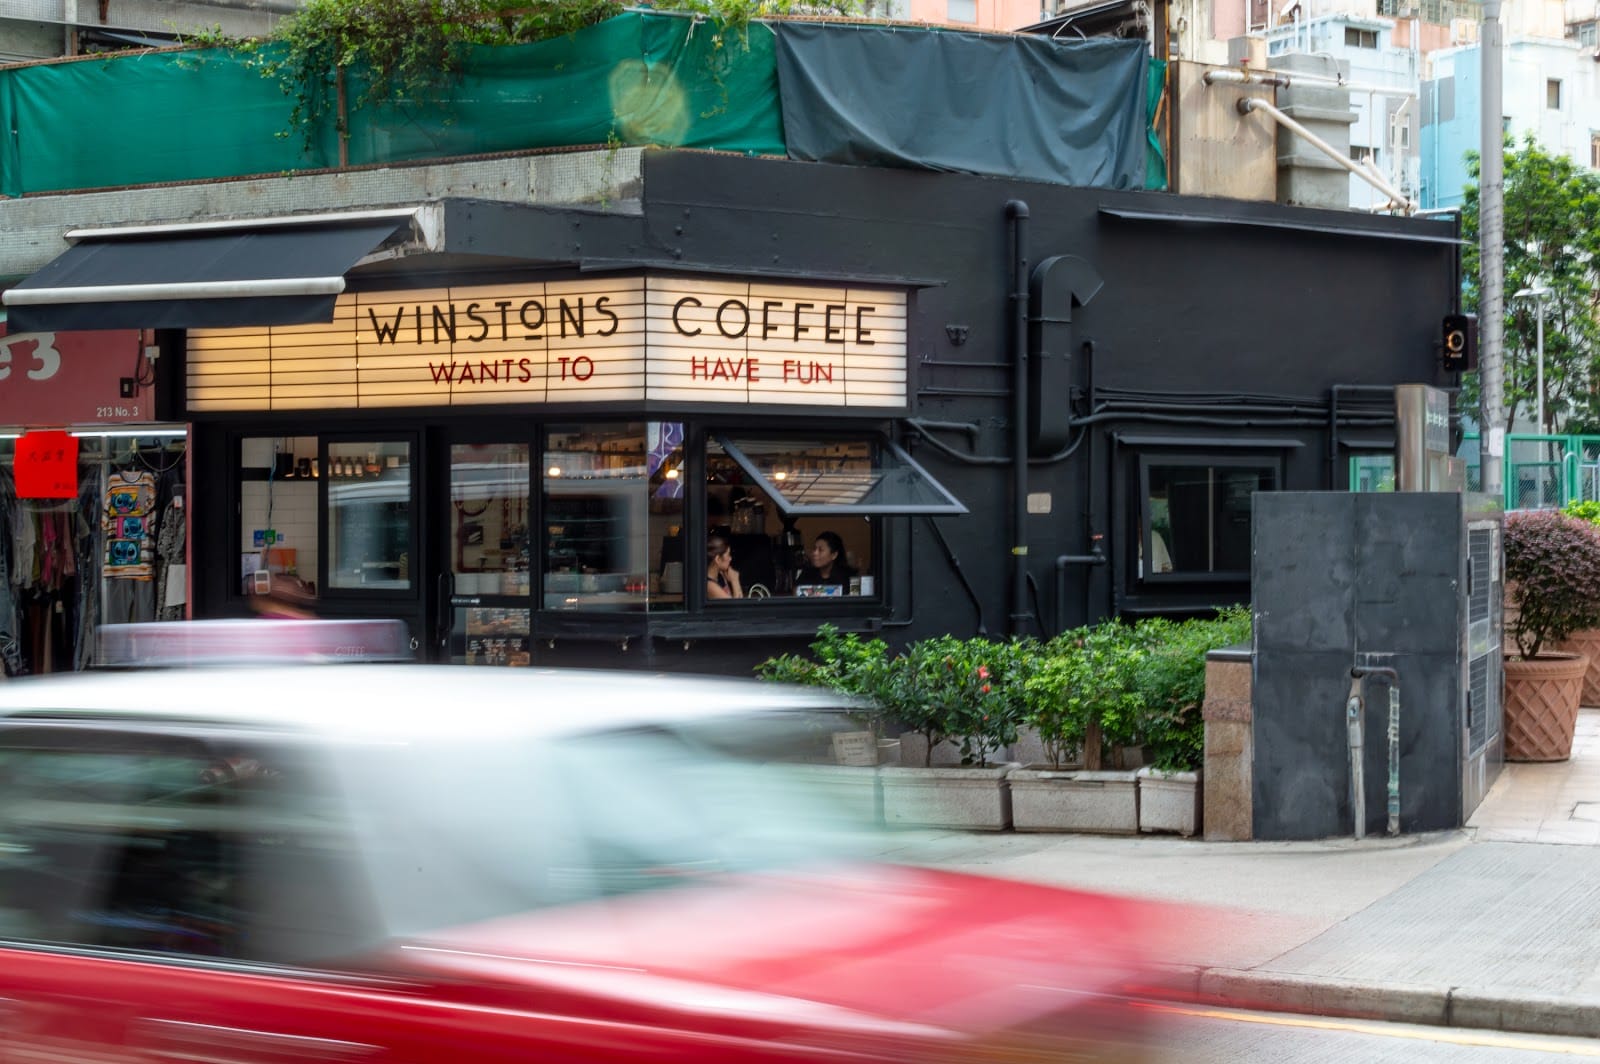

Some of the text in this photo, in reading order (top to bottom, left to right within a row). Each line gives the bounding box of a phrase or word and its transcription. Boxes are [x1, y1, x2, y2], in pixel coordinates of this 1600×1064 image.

[368, 297, 875, 345] WINSTONS COFFEE
[429, 356, 832, 385] WANTS TO HAVE FUN
[96, 406, 139, 417] 213 No. 3
